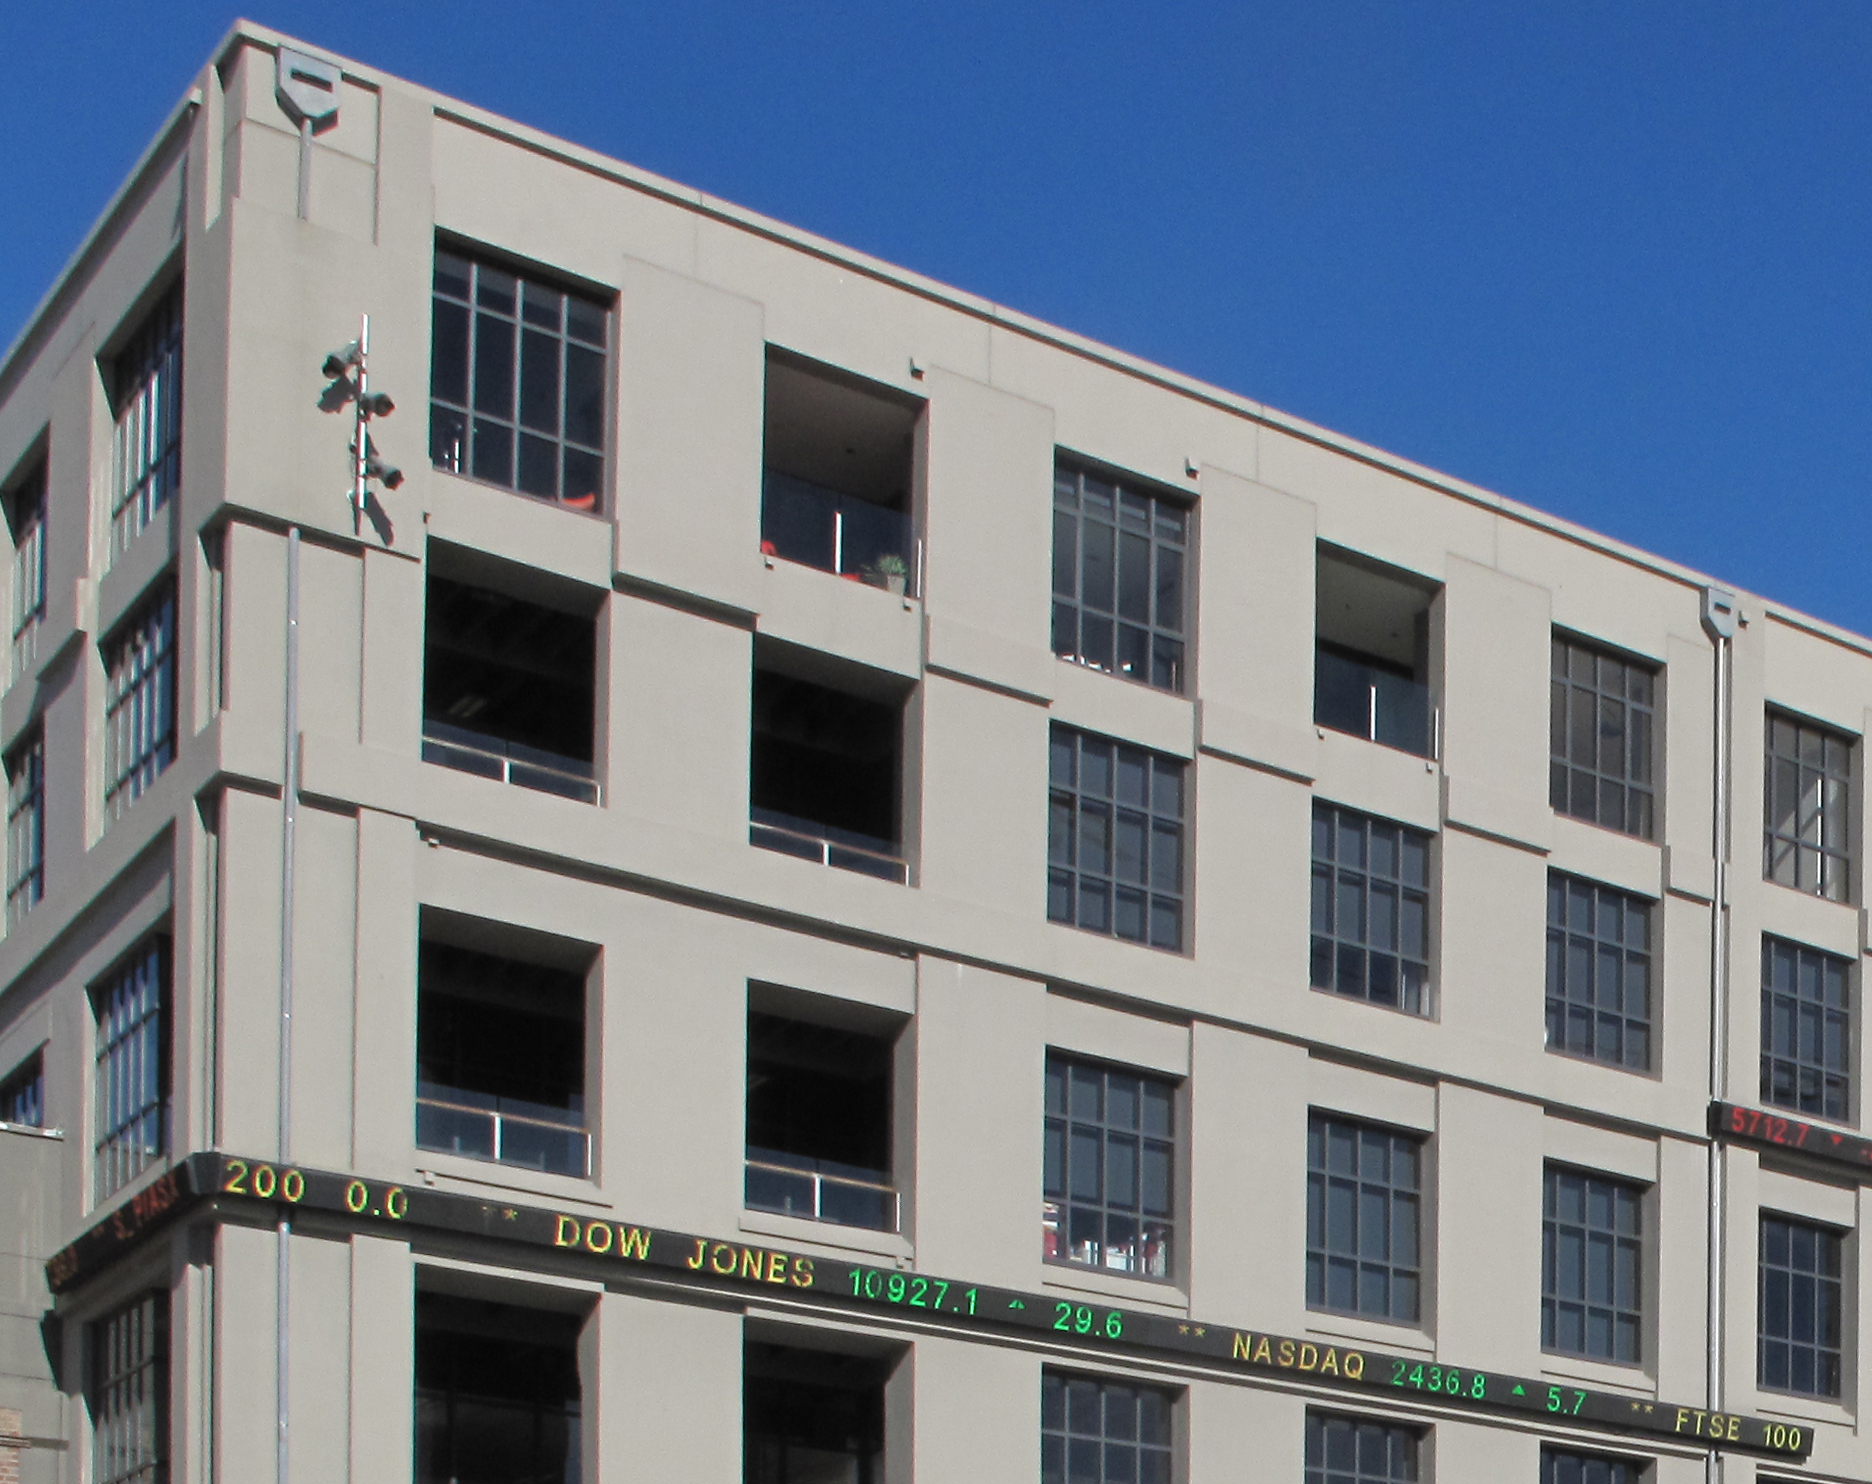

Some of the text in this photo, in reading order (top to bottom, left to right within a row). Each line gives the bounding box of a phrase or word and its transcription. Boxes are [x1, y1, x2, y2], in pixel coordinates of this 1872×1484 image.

[1732, 1106, 1810, 1147] 5712.7
[223, 1159, 1801, 1451] 200 0.0 DOW JONES 10927.1 29.6 NASDAQ 2436.8 5.7 FTSE 100
